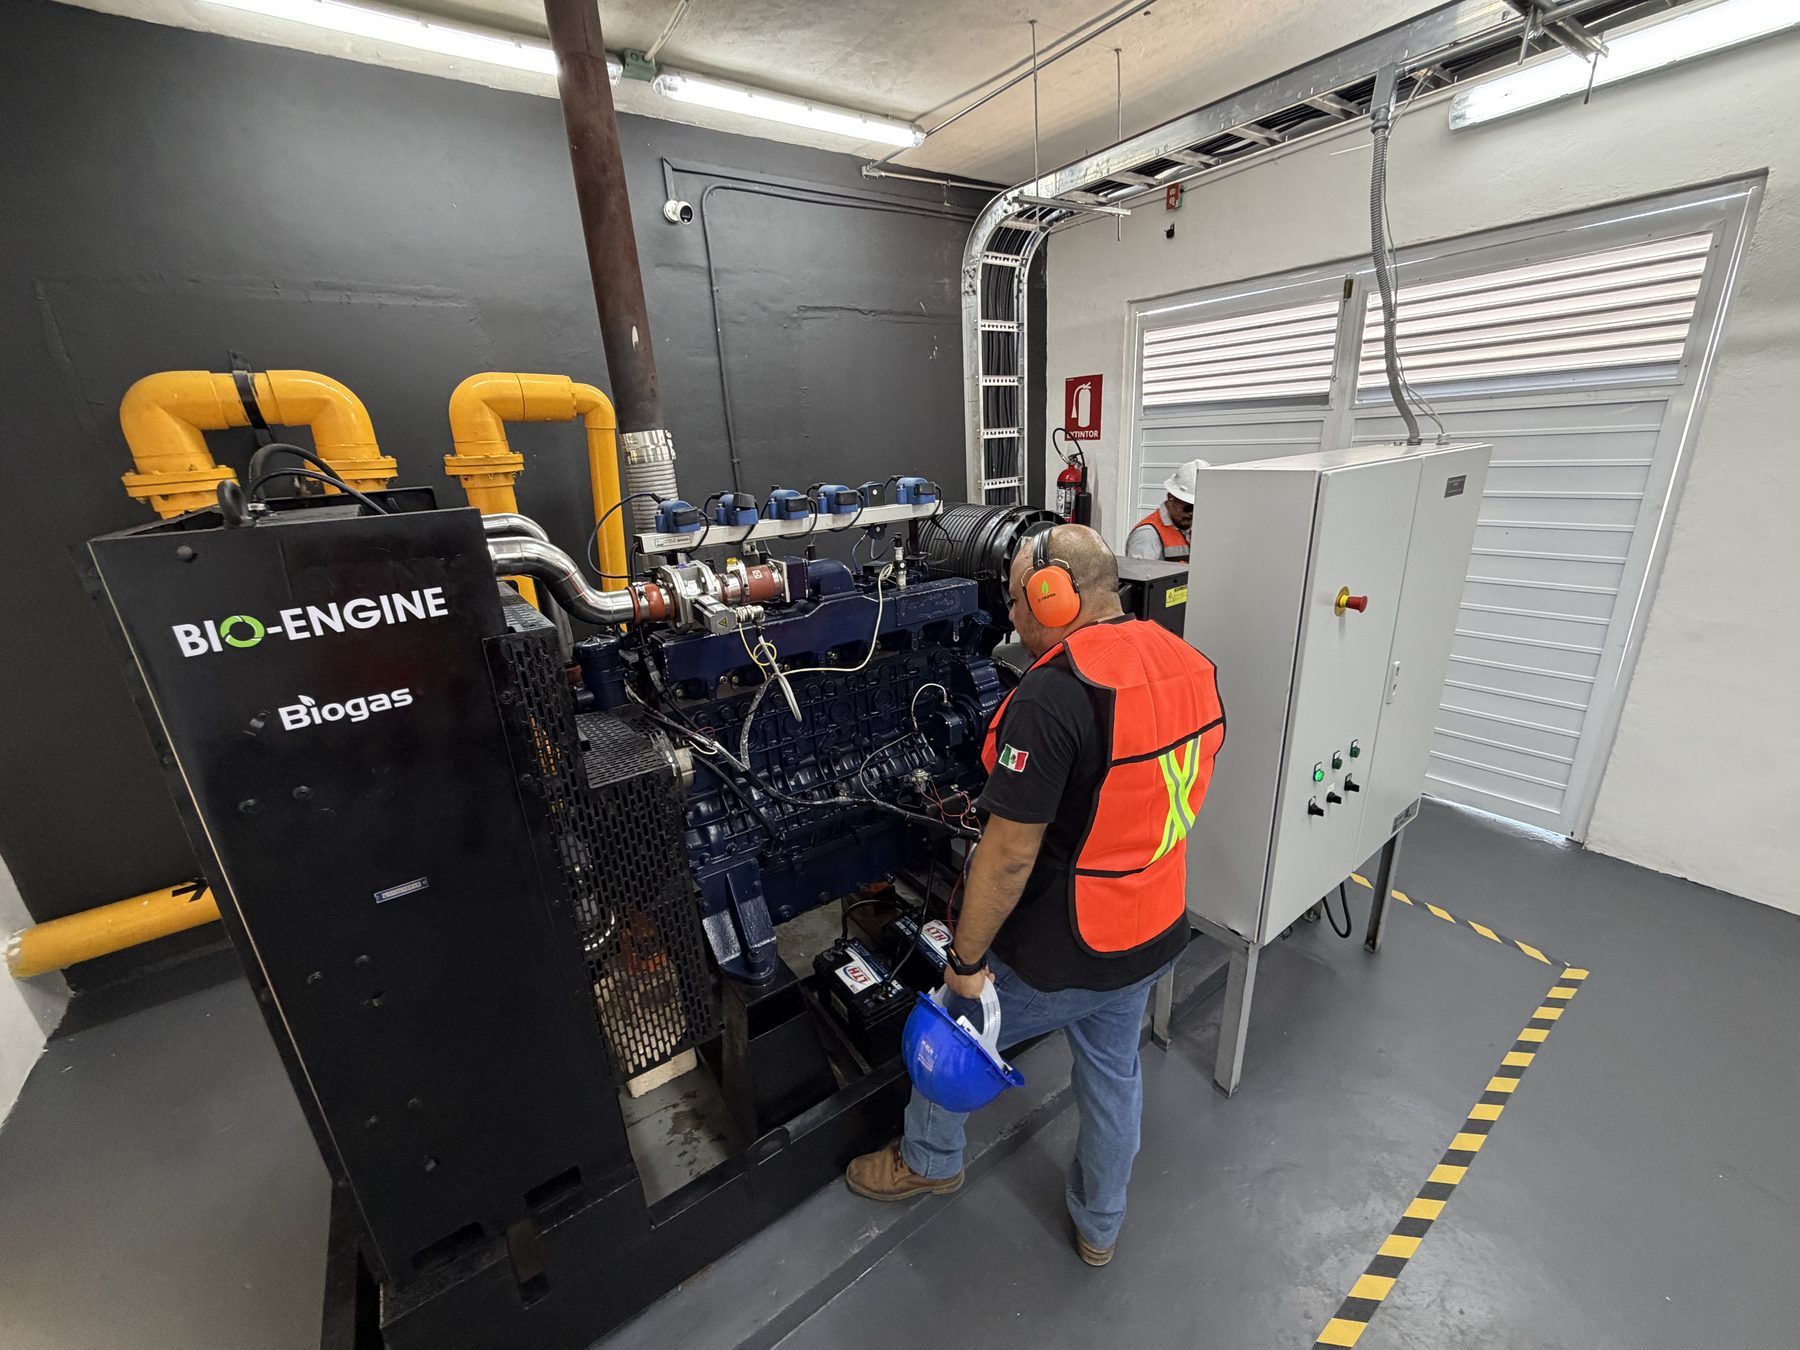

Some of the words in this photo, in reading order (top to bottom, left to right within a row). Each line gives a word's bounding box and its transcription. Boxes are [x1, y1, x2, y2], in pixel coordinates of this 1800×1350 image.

[172, 587, 448, 658] BIO-ENGINE
[278, 688, 413, 731] Biogas
[926, 927, 946, 942] LTH
[847, 966, 870, 985] LTH
